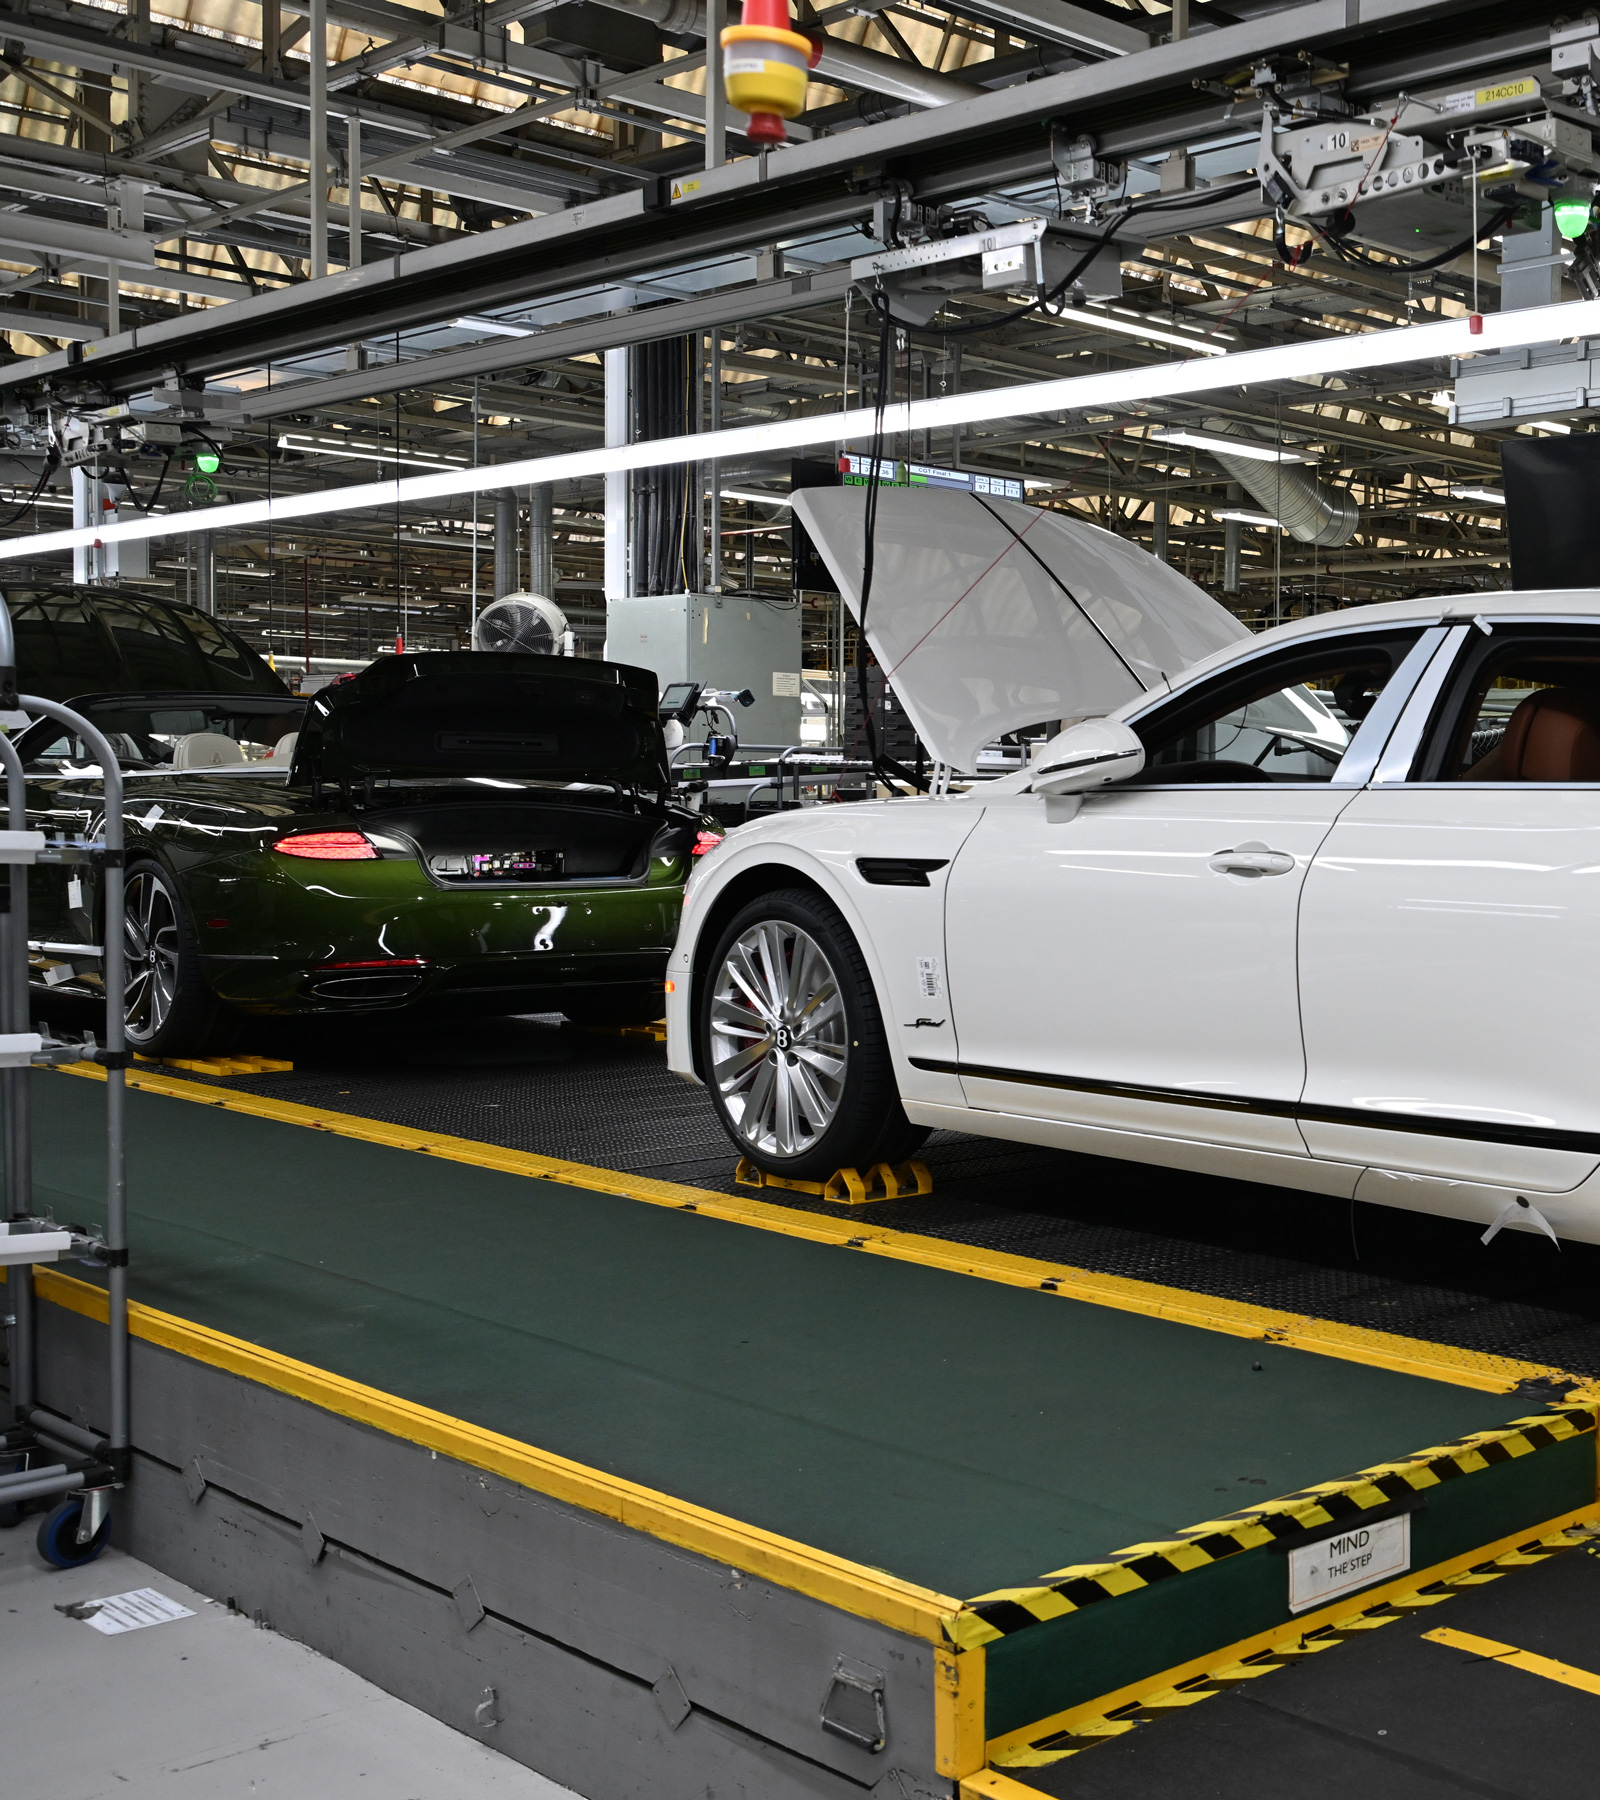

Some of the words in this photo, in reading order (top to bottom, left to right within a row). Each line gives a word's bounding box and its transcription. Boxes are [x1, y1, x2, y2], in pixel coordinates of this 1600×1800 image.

[1485, 83, 1524, 101] 214CC10
[1331, 133, 1346, 149] 10
[982, 237, 993, 252] 10
[776, 1029, 788, 1048] B
[1330, 1530, 1370, 1558] MIND
[1328, 1561, 1348, 1579] THE
[1350, 1552, 1373, 1571] STEP
